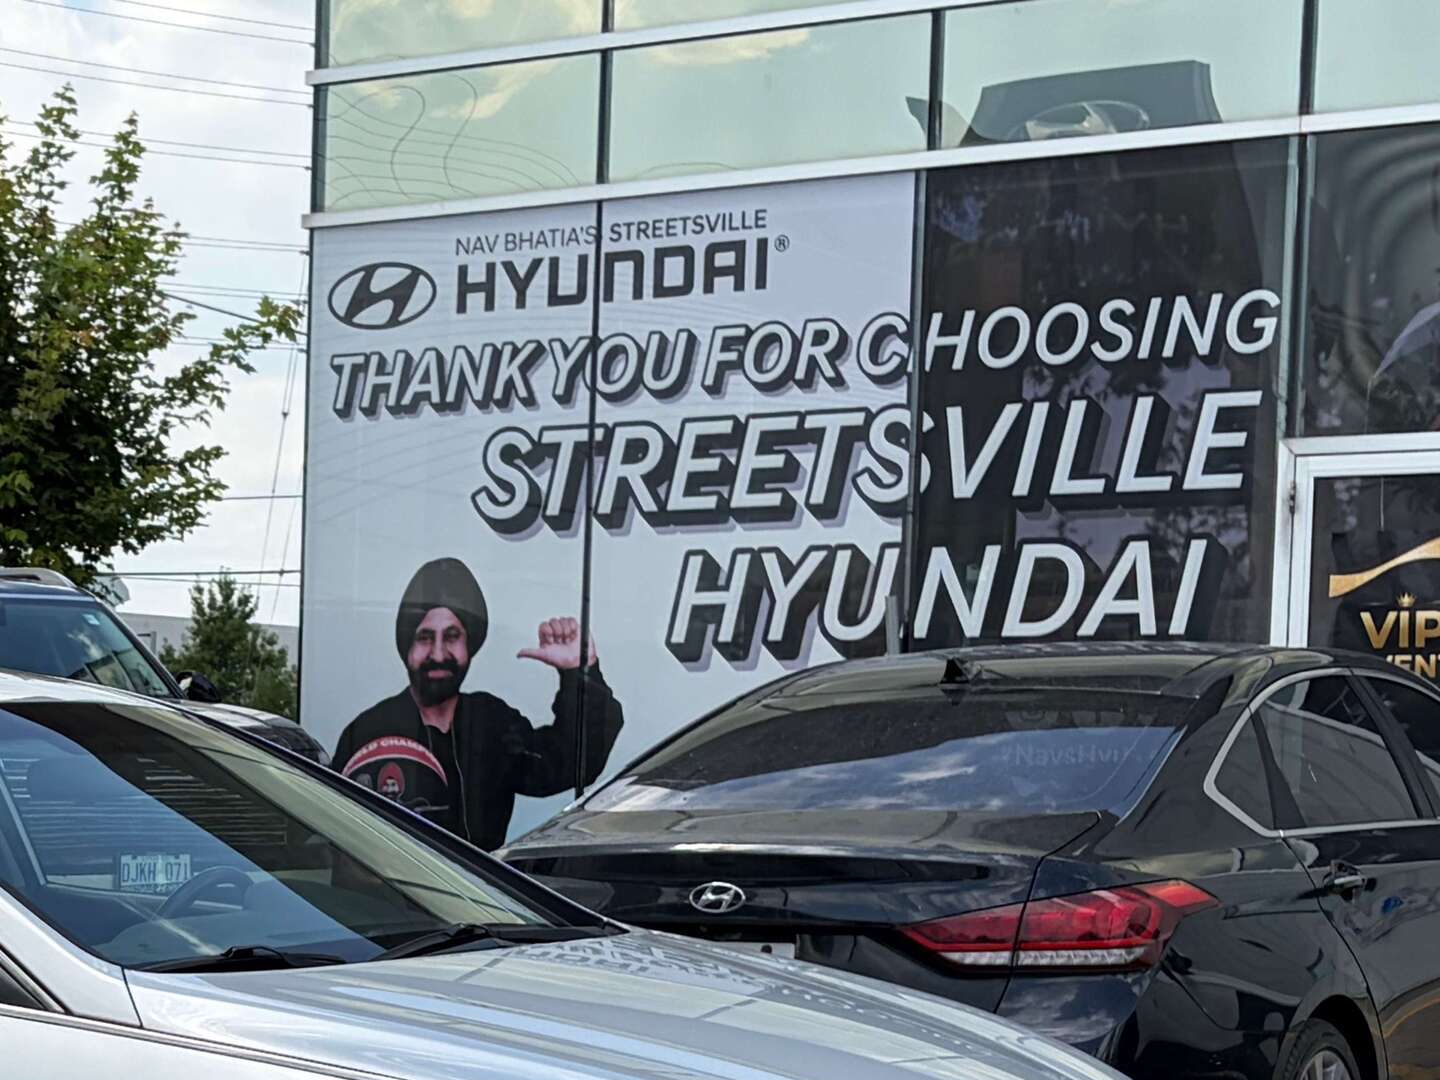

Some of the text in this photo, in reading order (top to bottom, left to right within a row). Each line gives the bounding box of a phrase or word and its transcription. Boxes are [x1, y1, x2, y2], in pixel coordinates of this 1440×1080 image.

[455, 209, 768, 256] NAV BHATIA'S STREETSVILLE
[330, 289, 1282, 421] THANK YOU FOR CHOOSING
[471, 390, 1262, 537] STREETSVILLE
[665, 537, 1210, 670] HYUNDAI
[1360, 610, 1440, 649] VIP
